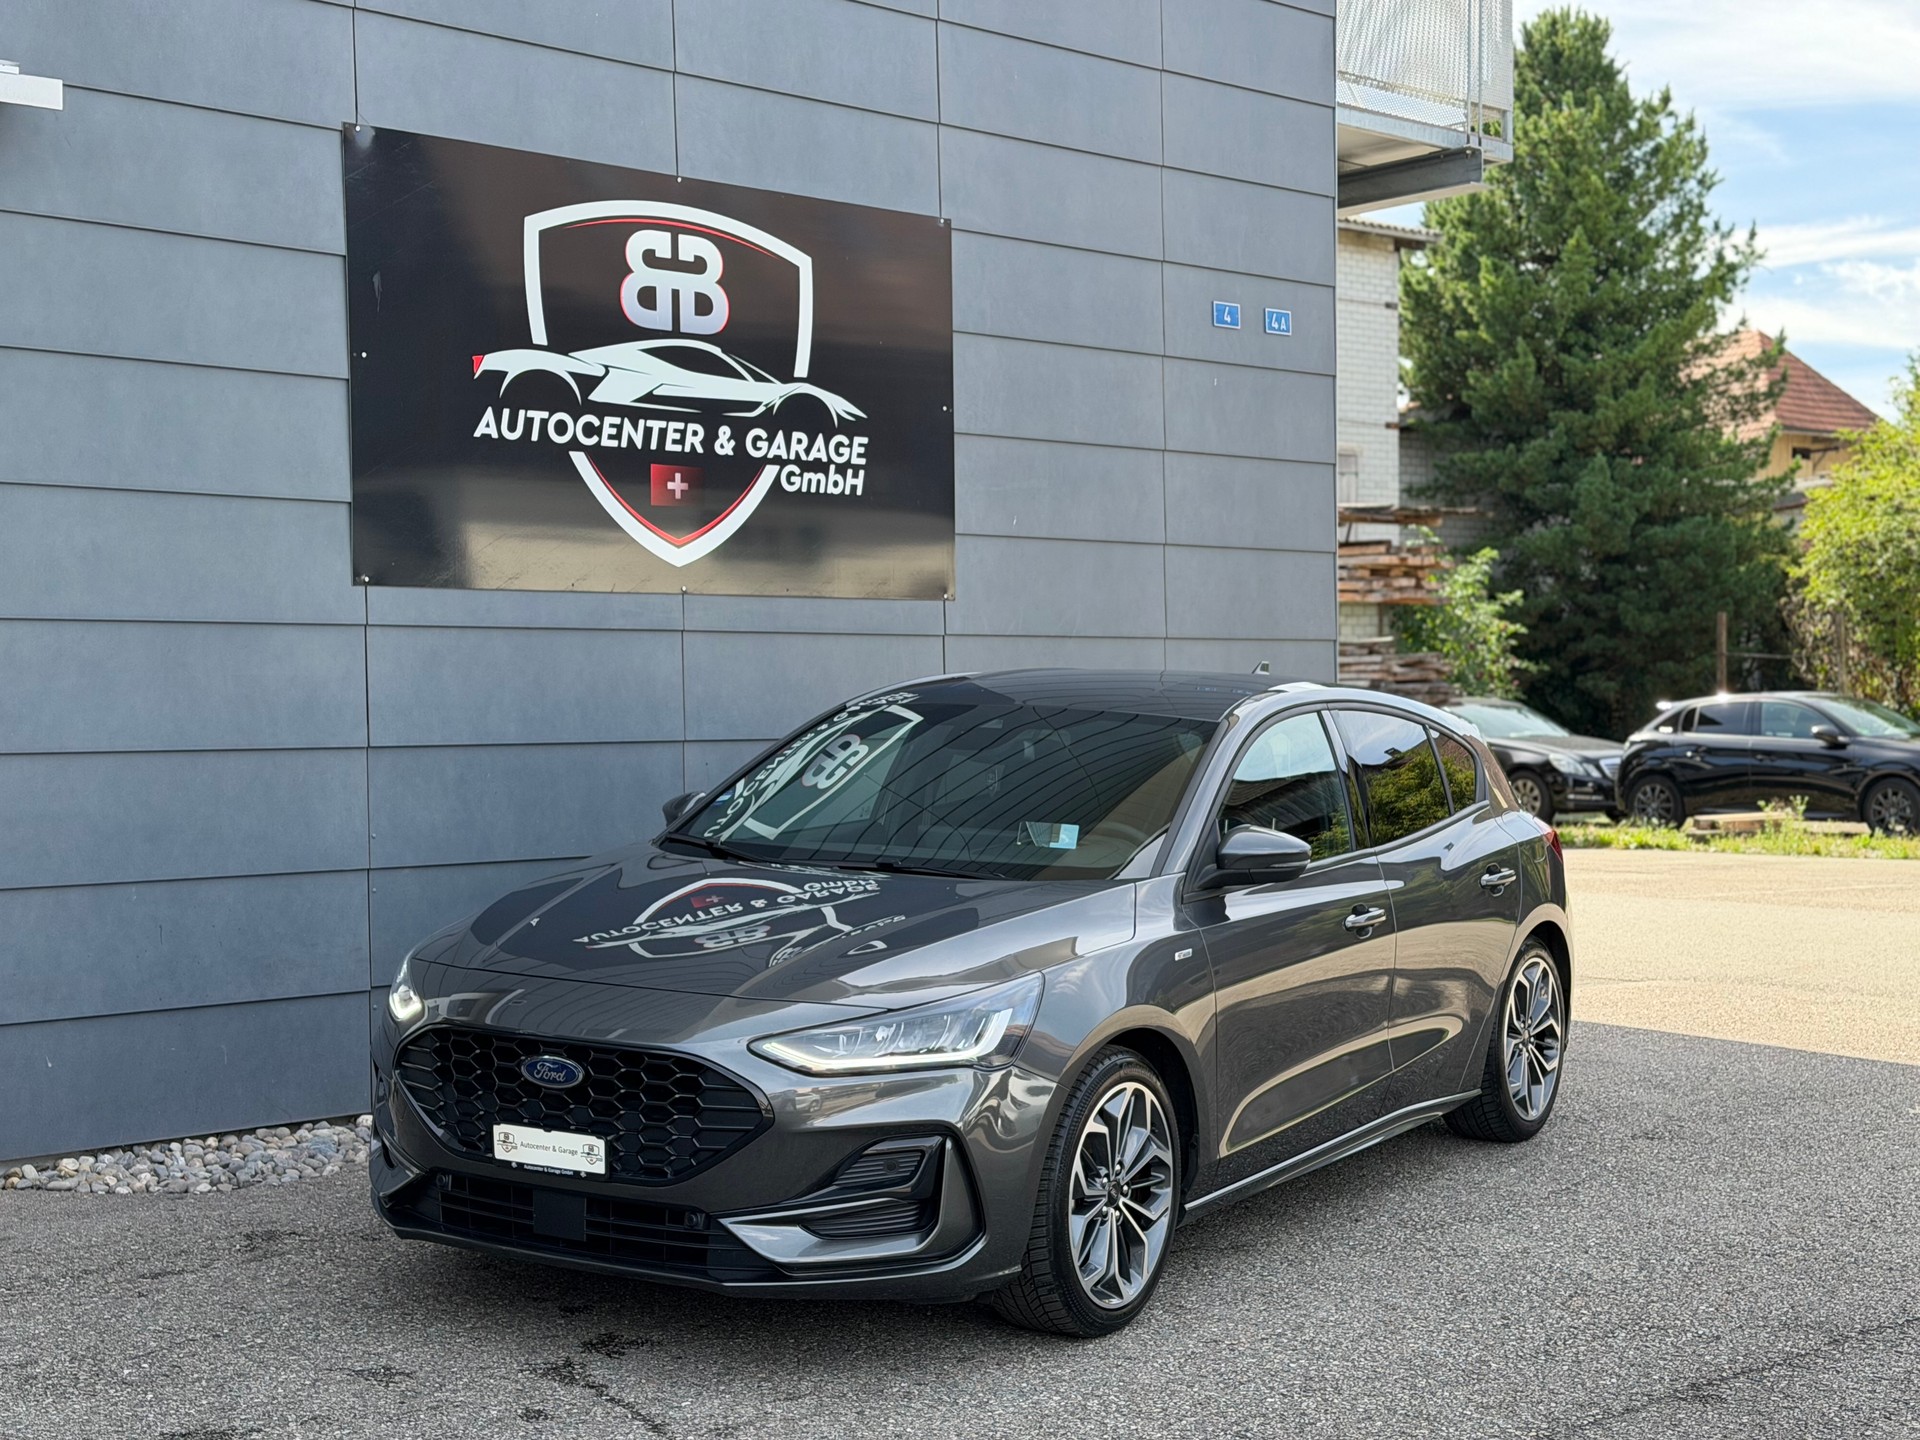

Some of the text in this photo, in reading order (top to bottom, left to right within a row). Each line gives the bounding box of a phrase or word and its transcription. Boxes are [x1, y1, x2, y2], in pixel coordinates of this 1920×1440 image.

[1223, 307, 1231, 323] 4
[1271, 313, 1287, 331] 4A
[473, 406, 869, 465] AUTOCENTER & GARAGE
[779, 464, 865, 496] GmbH
[533, 1061, 566, 1082] Ford
[520, 1141, 551, 1152] Autocenter
[558, 1146, 579, 1156] Garage
